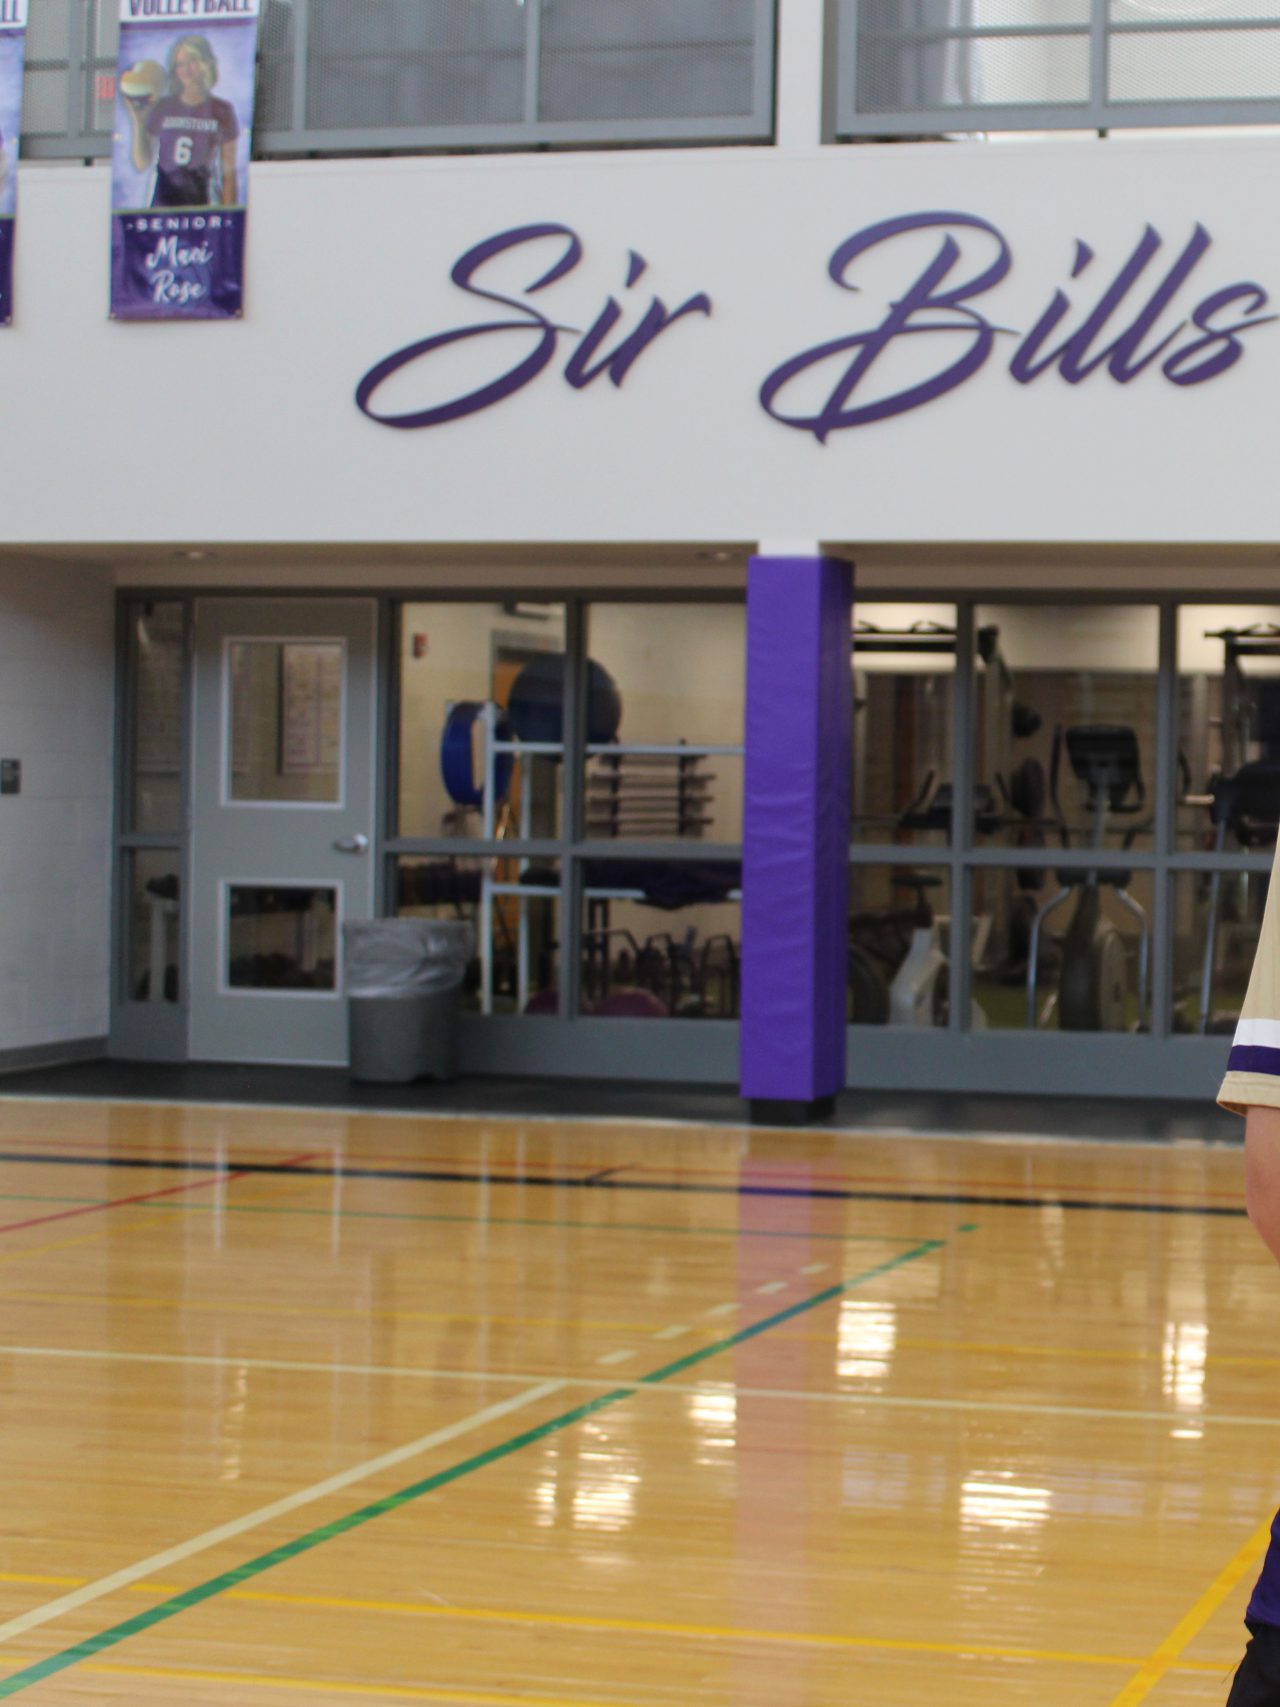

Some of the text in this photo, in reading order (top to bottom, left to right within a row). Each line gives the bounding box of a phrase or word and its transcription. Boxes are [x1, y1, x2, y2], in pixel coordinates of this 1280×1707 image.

[128, 0, 254, 16] VOLLEYBALL
[174, 136, 194, 166] 6
[136, 216, 222, 231] SENIOR
[354, 211, 1280, 446] Sir Bills
